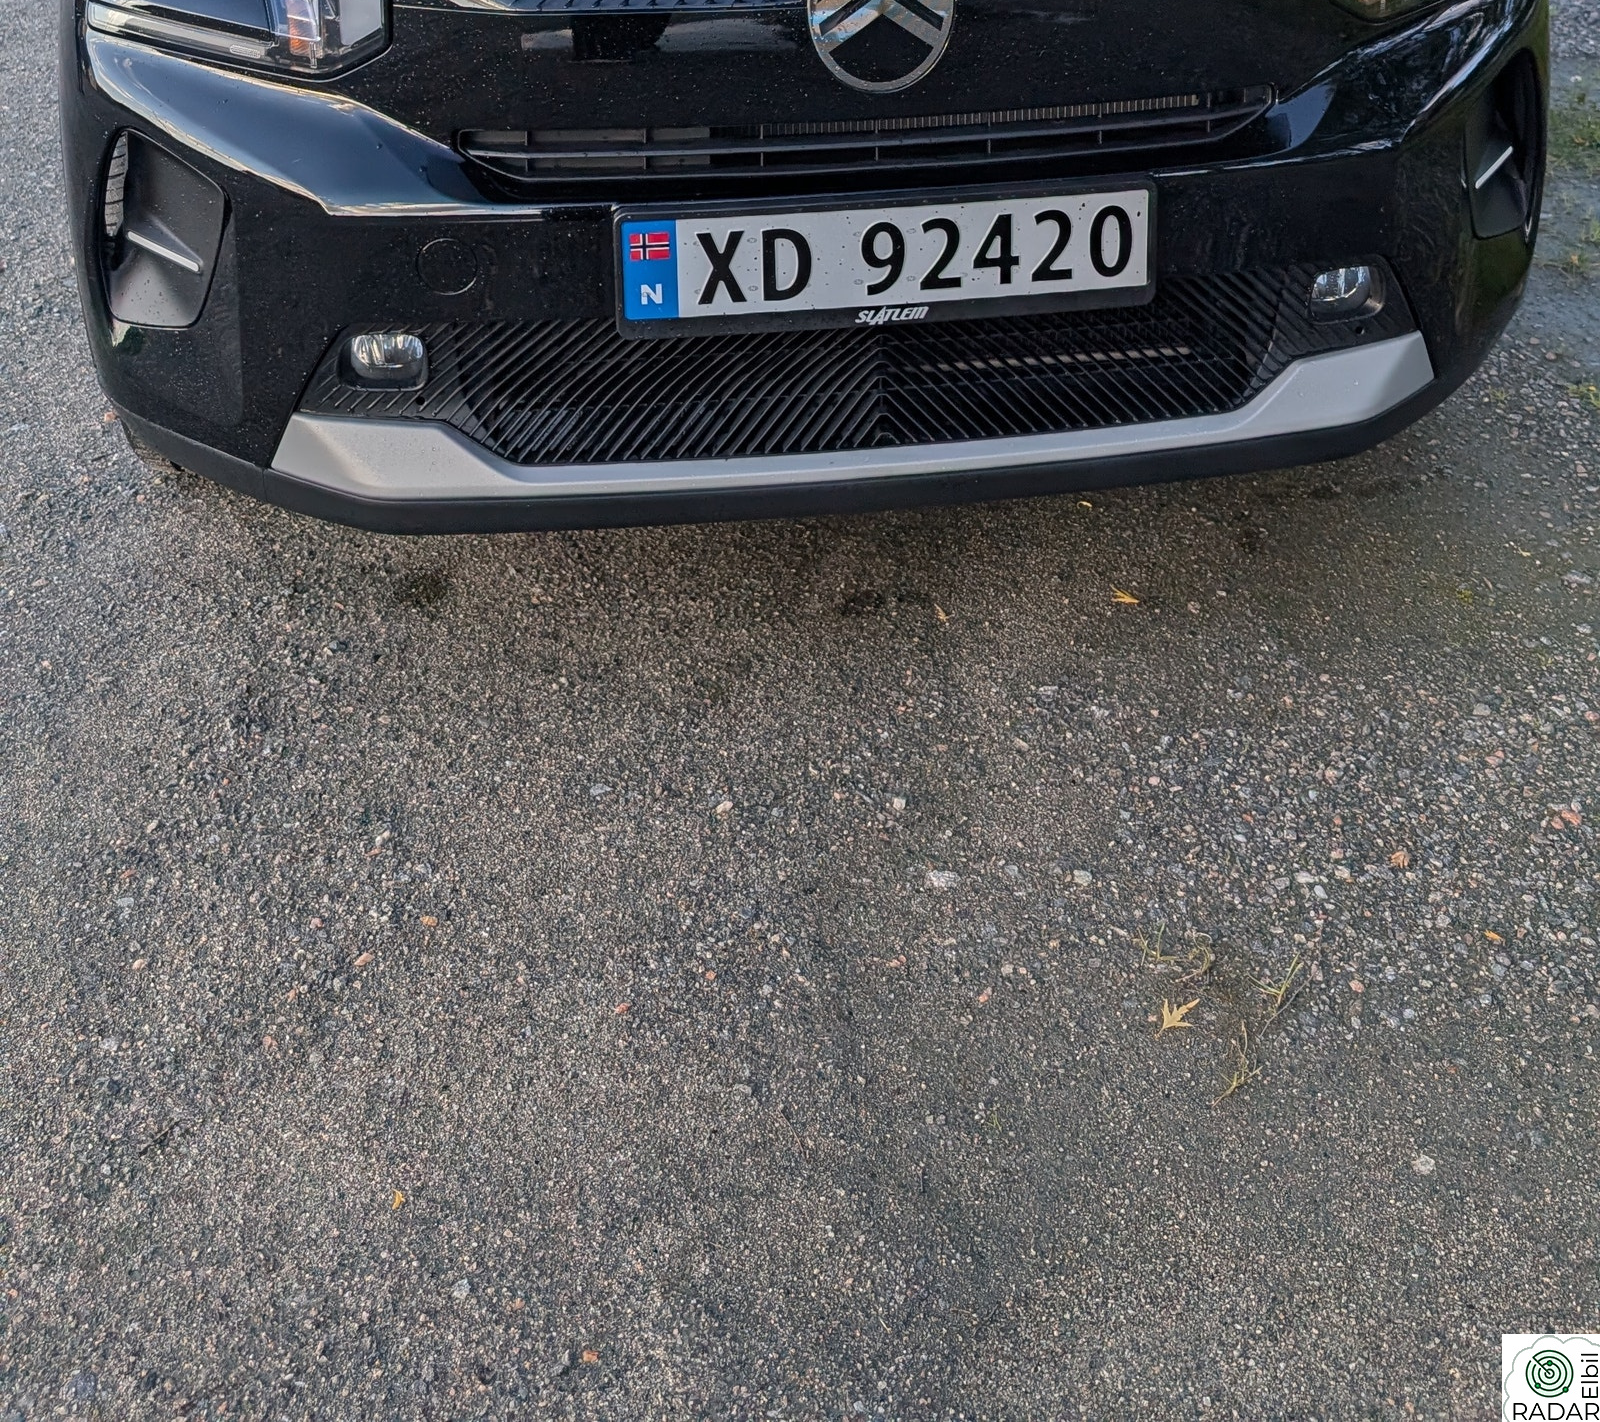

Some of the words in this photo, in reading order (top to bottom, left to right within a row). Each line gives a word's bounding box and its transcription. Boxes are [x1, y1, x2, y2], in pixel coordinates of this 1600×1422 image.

[696, 228, 812, 305] XD
[861, 204, 1133, 296] 92420
[640, 283, 663, 305] N
